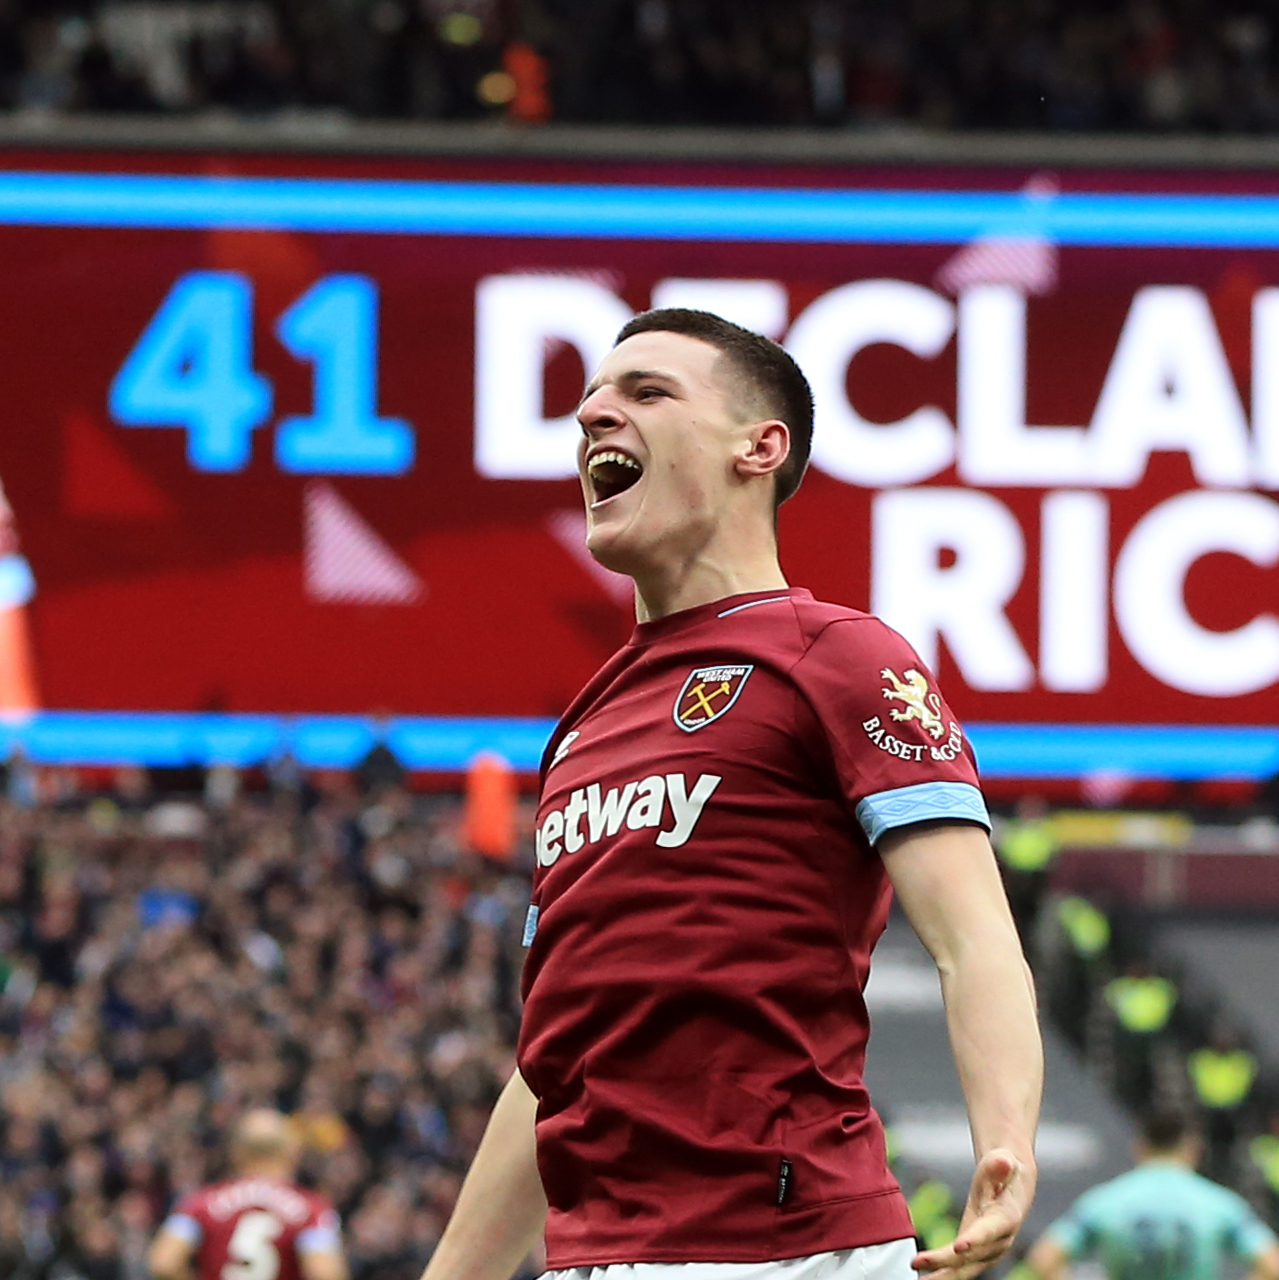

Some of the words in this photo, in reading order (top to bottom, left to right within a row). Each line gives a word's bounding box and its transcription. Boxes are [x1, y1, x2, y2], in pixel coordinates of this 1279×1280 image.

[109, 270, 416, 475] 41
[862, 716, 923, 761] BASSET
[536, 773, 722, 862] etway
